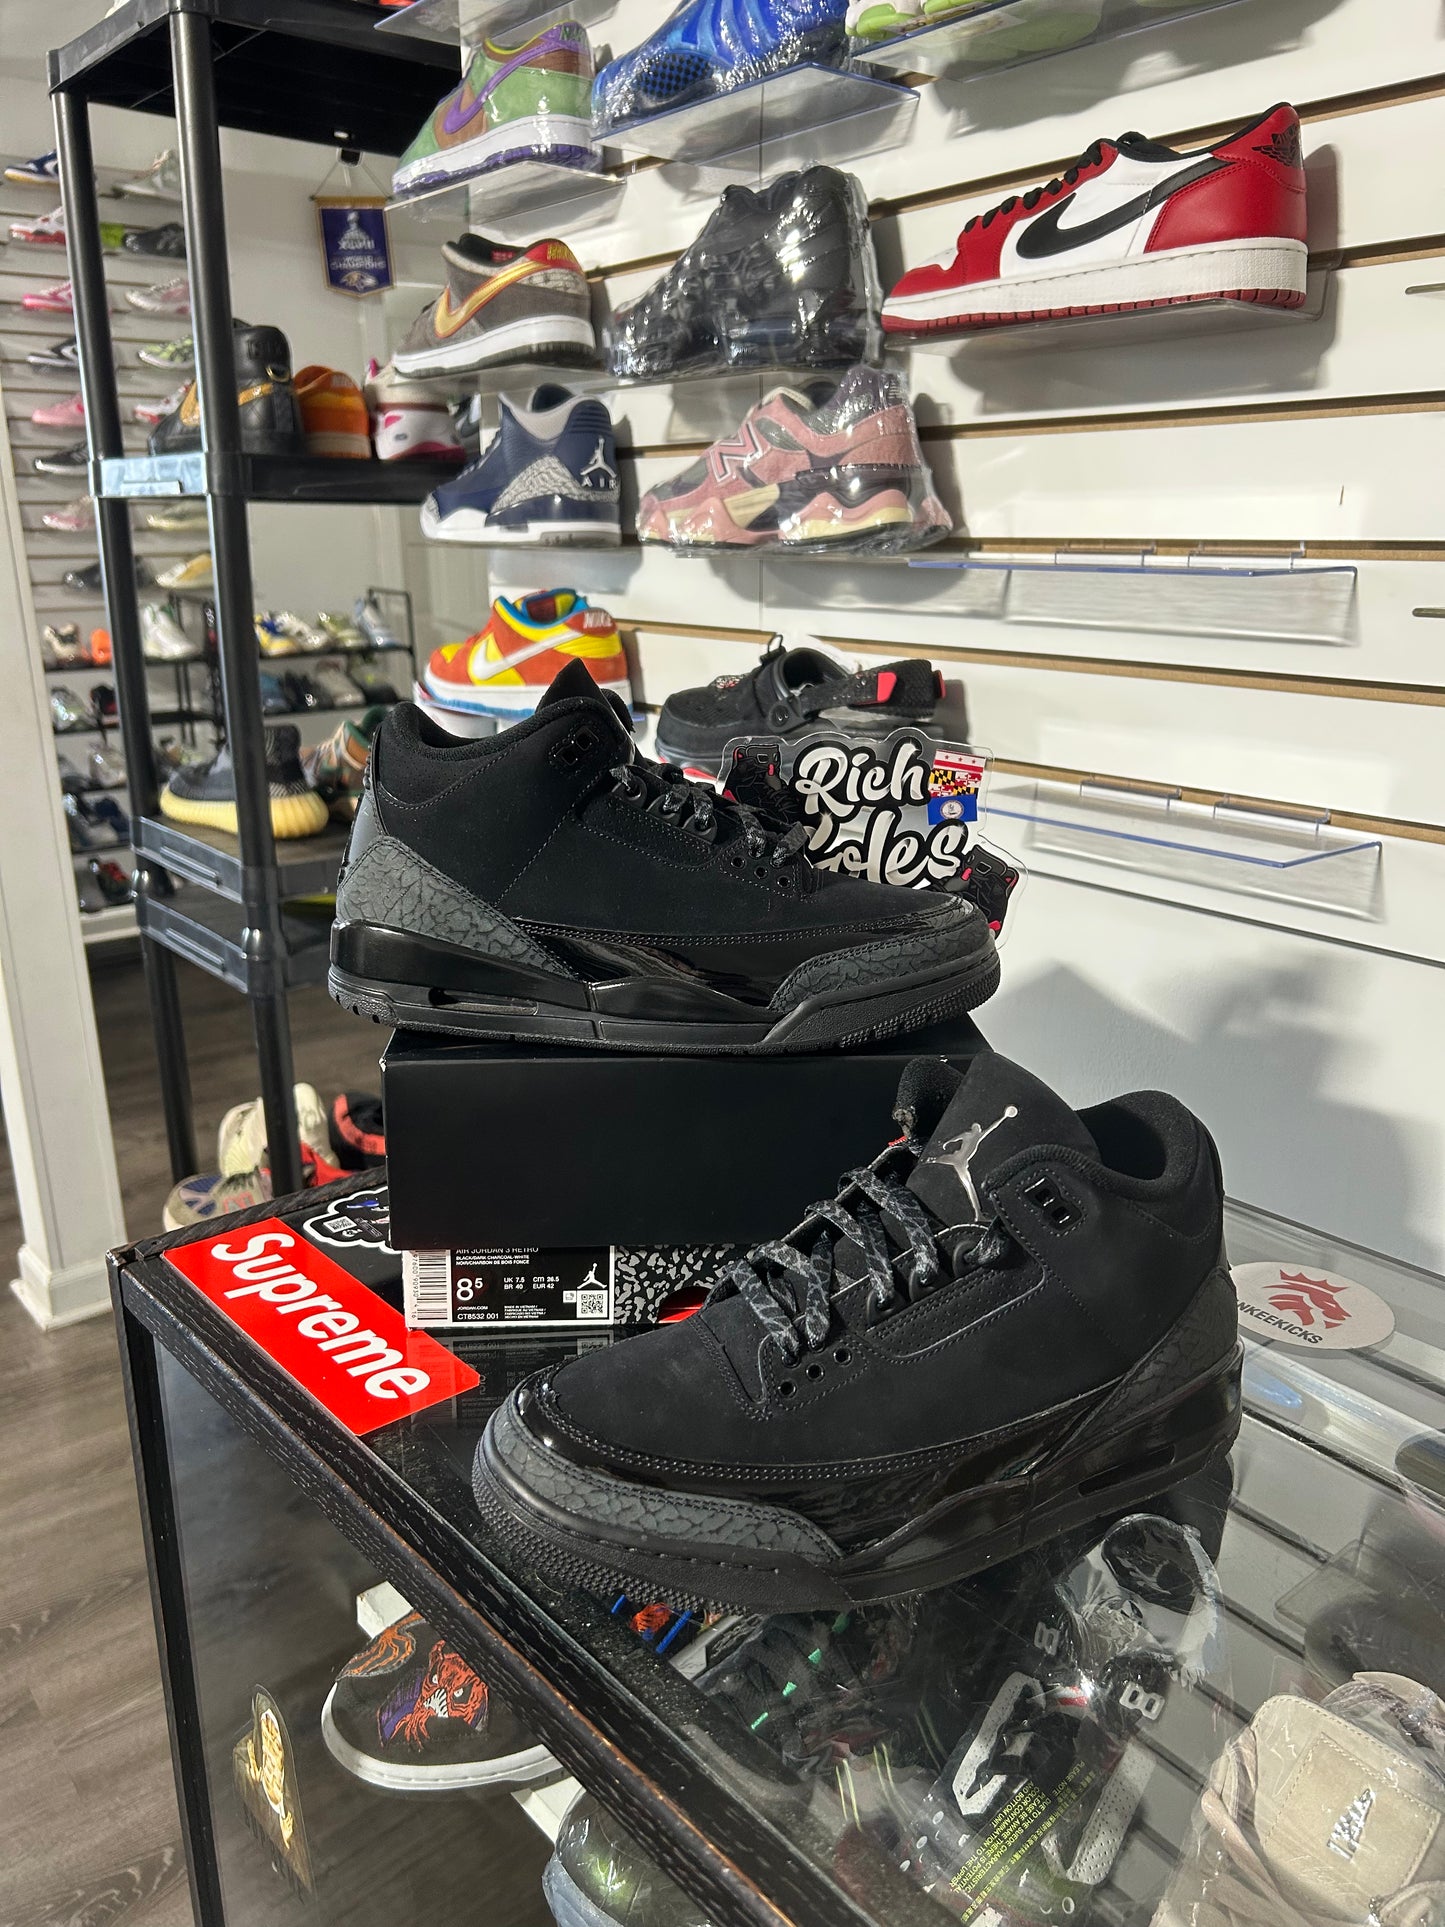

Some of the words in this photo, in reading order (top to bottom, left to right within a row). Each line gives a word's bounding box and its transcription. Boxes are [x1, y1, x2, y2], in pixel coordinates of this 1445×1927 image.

[795, 743, 925, 816] Rich
[211, 1232, 431, 1399] Supreme
[1237, 1300, 1323, 1344] NKEEKICKS
[1064, 1759, 1085, 1782] PLEASE
[1020, 1785, 1040, 1806] COLOR
[1021, 1780, 1034, 1794] AND
[1051, 1779, 1067, 1796] NOTE
[1001, 1791, 1024, 1815] BOTTOM
[1025, 1791, 1046, 1813] PLEASE
[1038, 1797, 1051, 1810] DUE
[1018, 1810, 1028, 1821] BE
[1020, 1815, 1034, 1829] THE
[1031, 1808, 1041, 1818] TO
[982, 1803, 1024, 1848] CONTAMINATION
[1000, 1817, 1021, 1839] AWARE
[1004, 1825, 1024, 1847] SUEDE
[975, 1845, 985, 1855] TO
[984, 1836, 1003, 1857] THERE
[965, 1853, 978, 1867] THE
[978, 1855, 987, 1863] IS
[947, 1865, 968, 1887] UPPER
[951, 1861, 982, 1894] POTENTIAL
